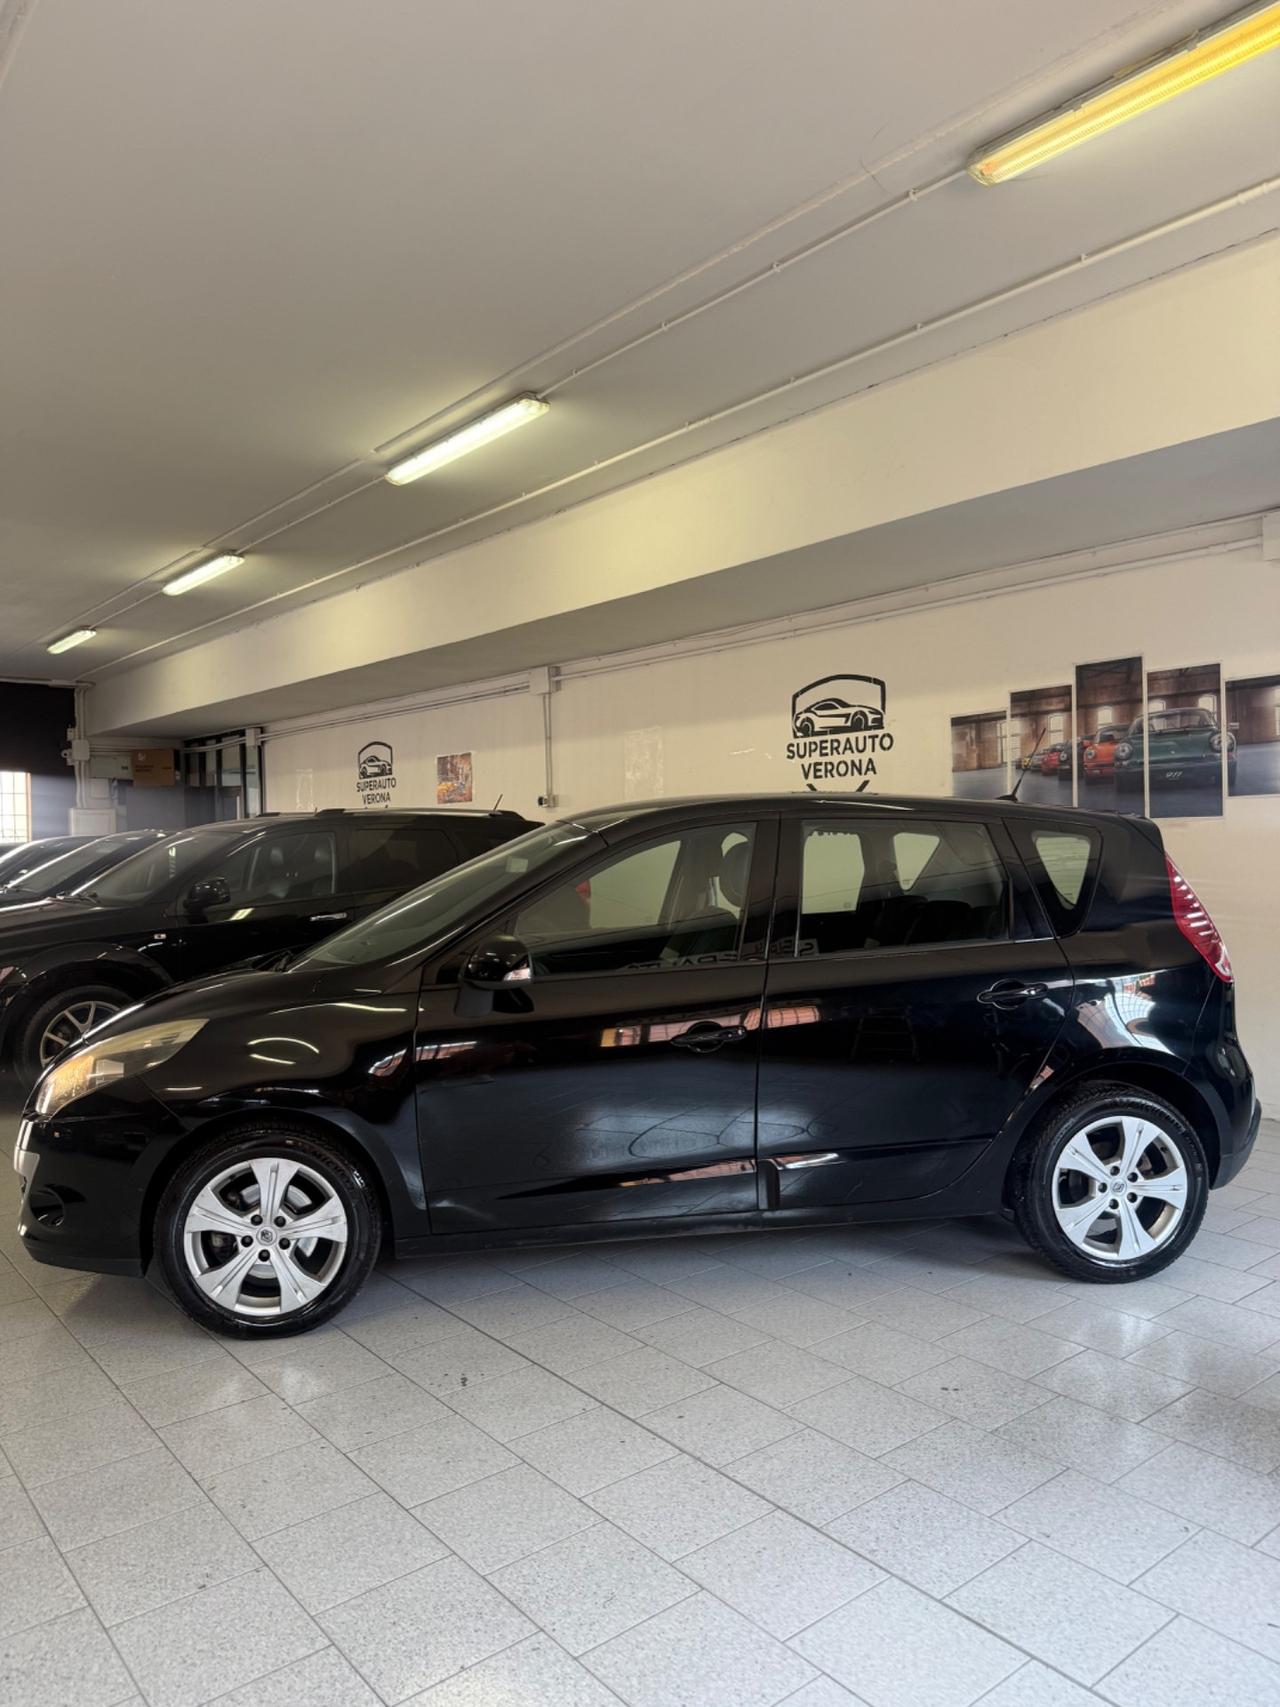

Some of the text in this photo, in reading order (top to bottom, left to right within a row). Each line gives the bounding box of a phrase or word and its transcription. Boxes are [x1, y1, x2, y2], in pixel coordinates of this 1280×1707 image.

[786, 733, 894, 759] SUPERAUTO
[801, 758, 877, 780] VERONA
[356, 777, 396, 792] SUPERAUTO
[362, 792, 391, 805] VERONA
